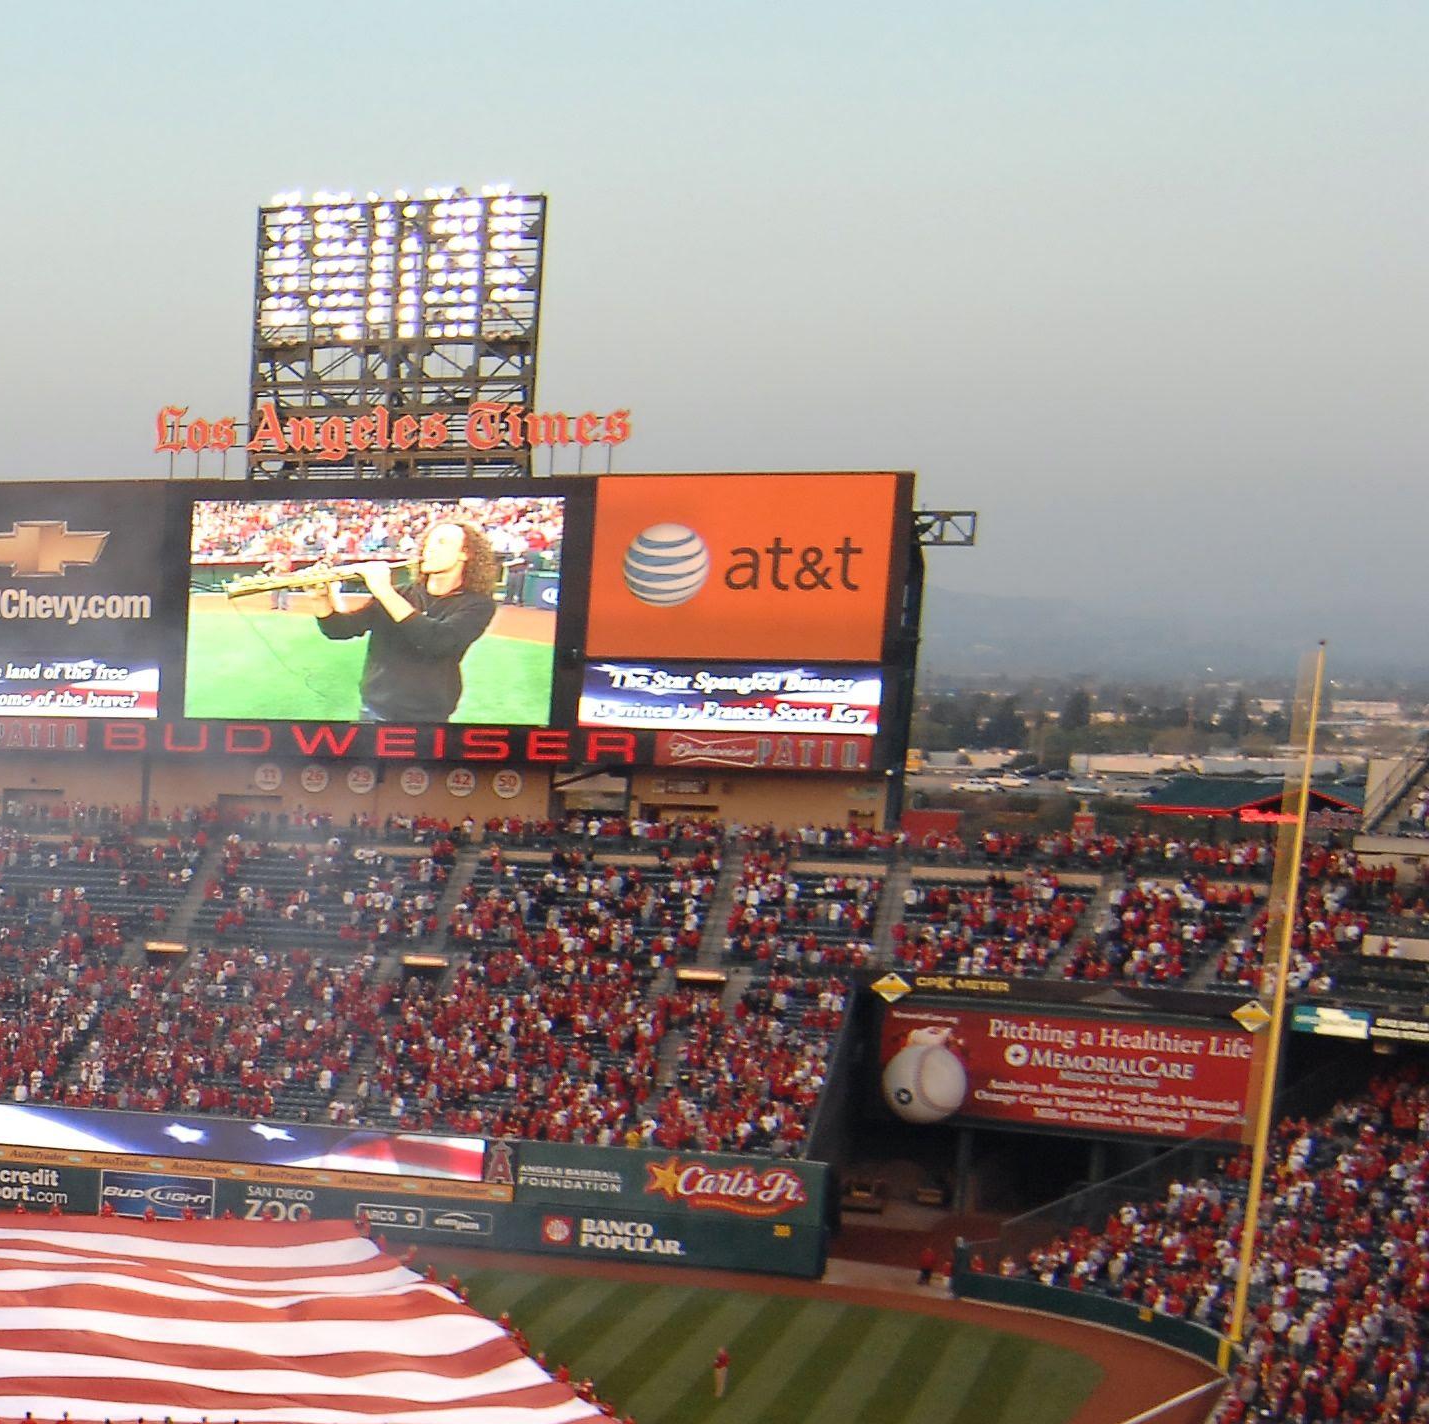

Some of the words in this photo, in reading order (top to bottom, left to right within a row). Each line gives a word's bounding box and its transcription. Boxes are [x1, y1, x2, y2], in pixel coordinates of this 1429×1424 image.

[153, 405, 237, 454] Los
[246, 402, 448, 461] Angeles
[465, 401, 631, 450] Times
[724, 537, 863, 591] at&t
[6, 664, 40, 680] land
[43, 664, 63, 680] of
[65, 664, 92, 680] the
[95, 664, 129, 680] free
[609, 670, 649, 688] The
[651, 671, 691, 689] Star
[693, 671, 783, 694] Spangled
[784, 673, 854, 692] Banner
[34, 691, 55, 706] of
[56, 692, 84, 707] the
[88, 692, 139, 708] brave?
[677, 704, 696, 721] by
[701, 702, 771, 722] Francis
[774, 703, 827, 722] Scott
[829, 704, 869, 724] Key
[103, 723, 637, 763] BUDWEISER
[498, 775, 516, 787] 50
[955, 979, 1010, 992] METER
[989, 1019, 1076, 1049] Pitching
[1081, 1030, 1094, 1046] a
[1101, 1027, 1204, 1055] Healthier
[1208, 1036, 1252, 1059] Life
[247, 1185, 272, 1197] SAN
[276, 1187, 315, 1201] DIEGO
[519, 1176, 622, 1193] FOUNDATION
[676, 1166, 758, 1196] Carl's
[757, 1172, 805, 1202] Jr.
[103, 1186, 145, 1198] BUD
[154, 1190, 212, 1204] LIGHT
[244, 1199, 312, 1222] ZOO
[580, 1218, 653, 1238] BANCO
[579, 1234, 682, 1255] POPULAR
